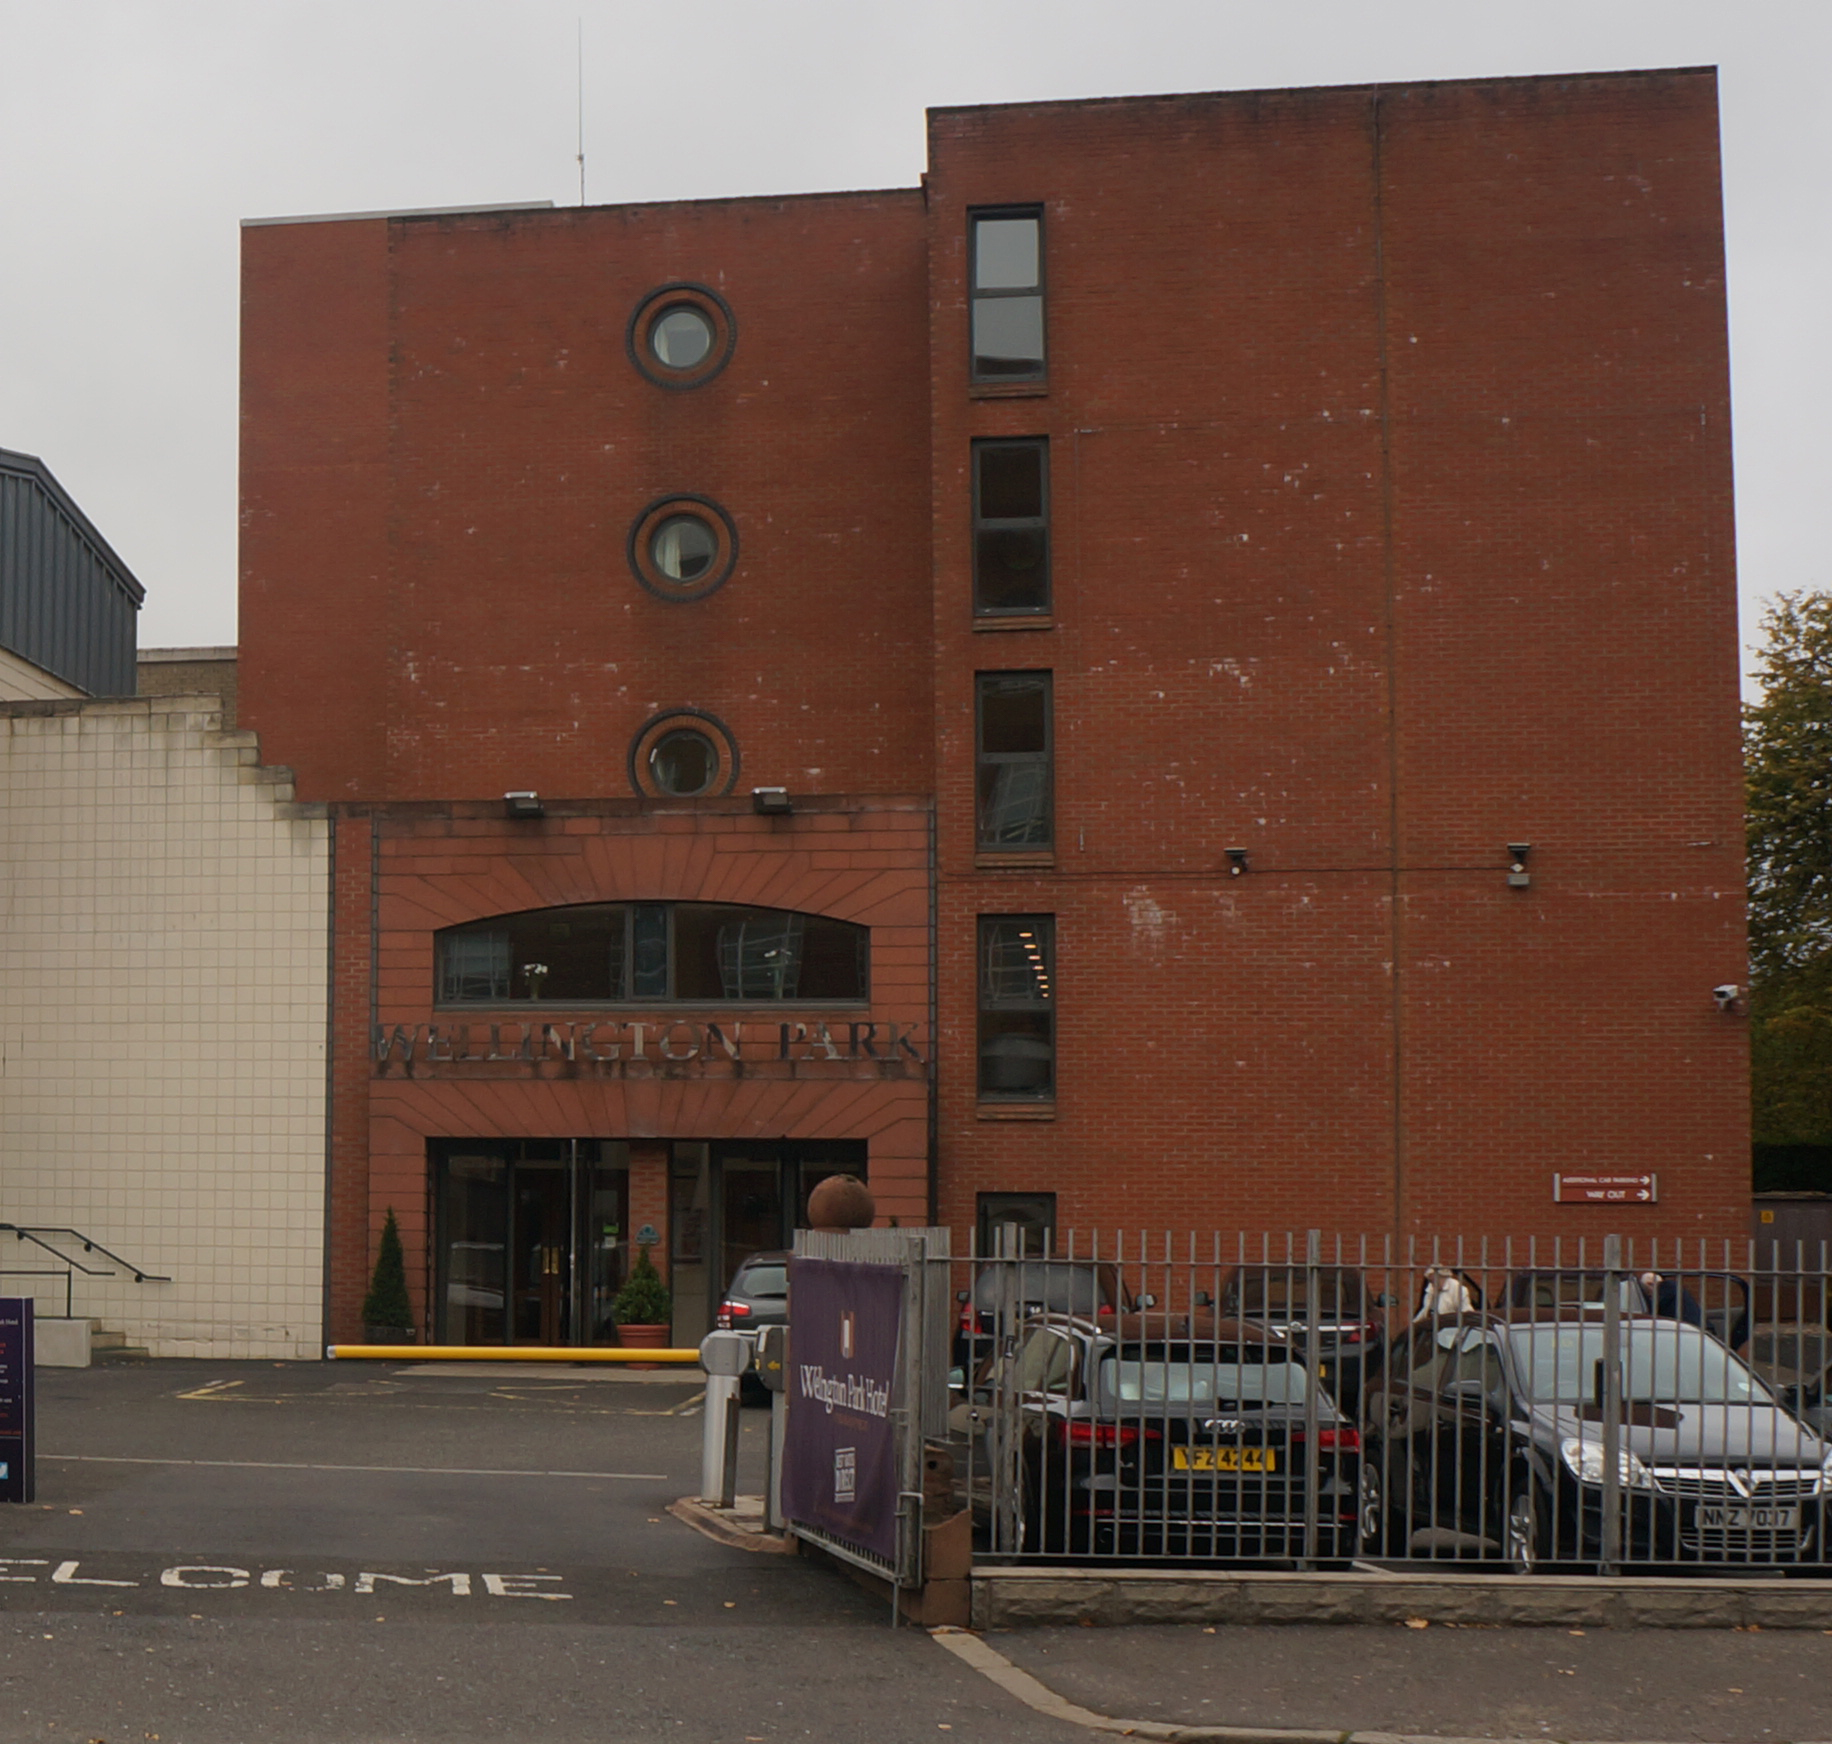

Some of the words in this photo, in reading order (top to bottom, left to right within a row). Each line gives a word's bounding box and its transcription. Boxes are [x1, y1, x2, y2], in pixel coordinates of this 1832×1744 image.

[375, 1020, 741, 1062] WELLINGTON
[776, 1020, 925, 1064] PARK
[1586, 1190, 1605, 1199] WAY
[1607, 1190, 1626, 1199] OUT
[847, 1373, 865, 1412] Park
[865, 1377, 890, 1418] Hotel
[1703, 1508, 1740, 1527] NNZ
